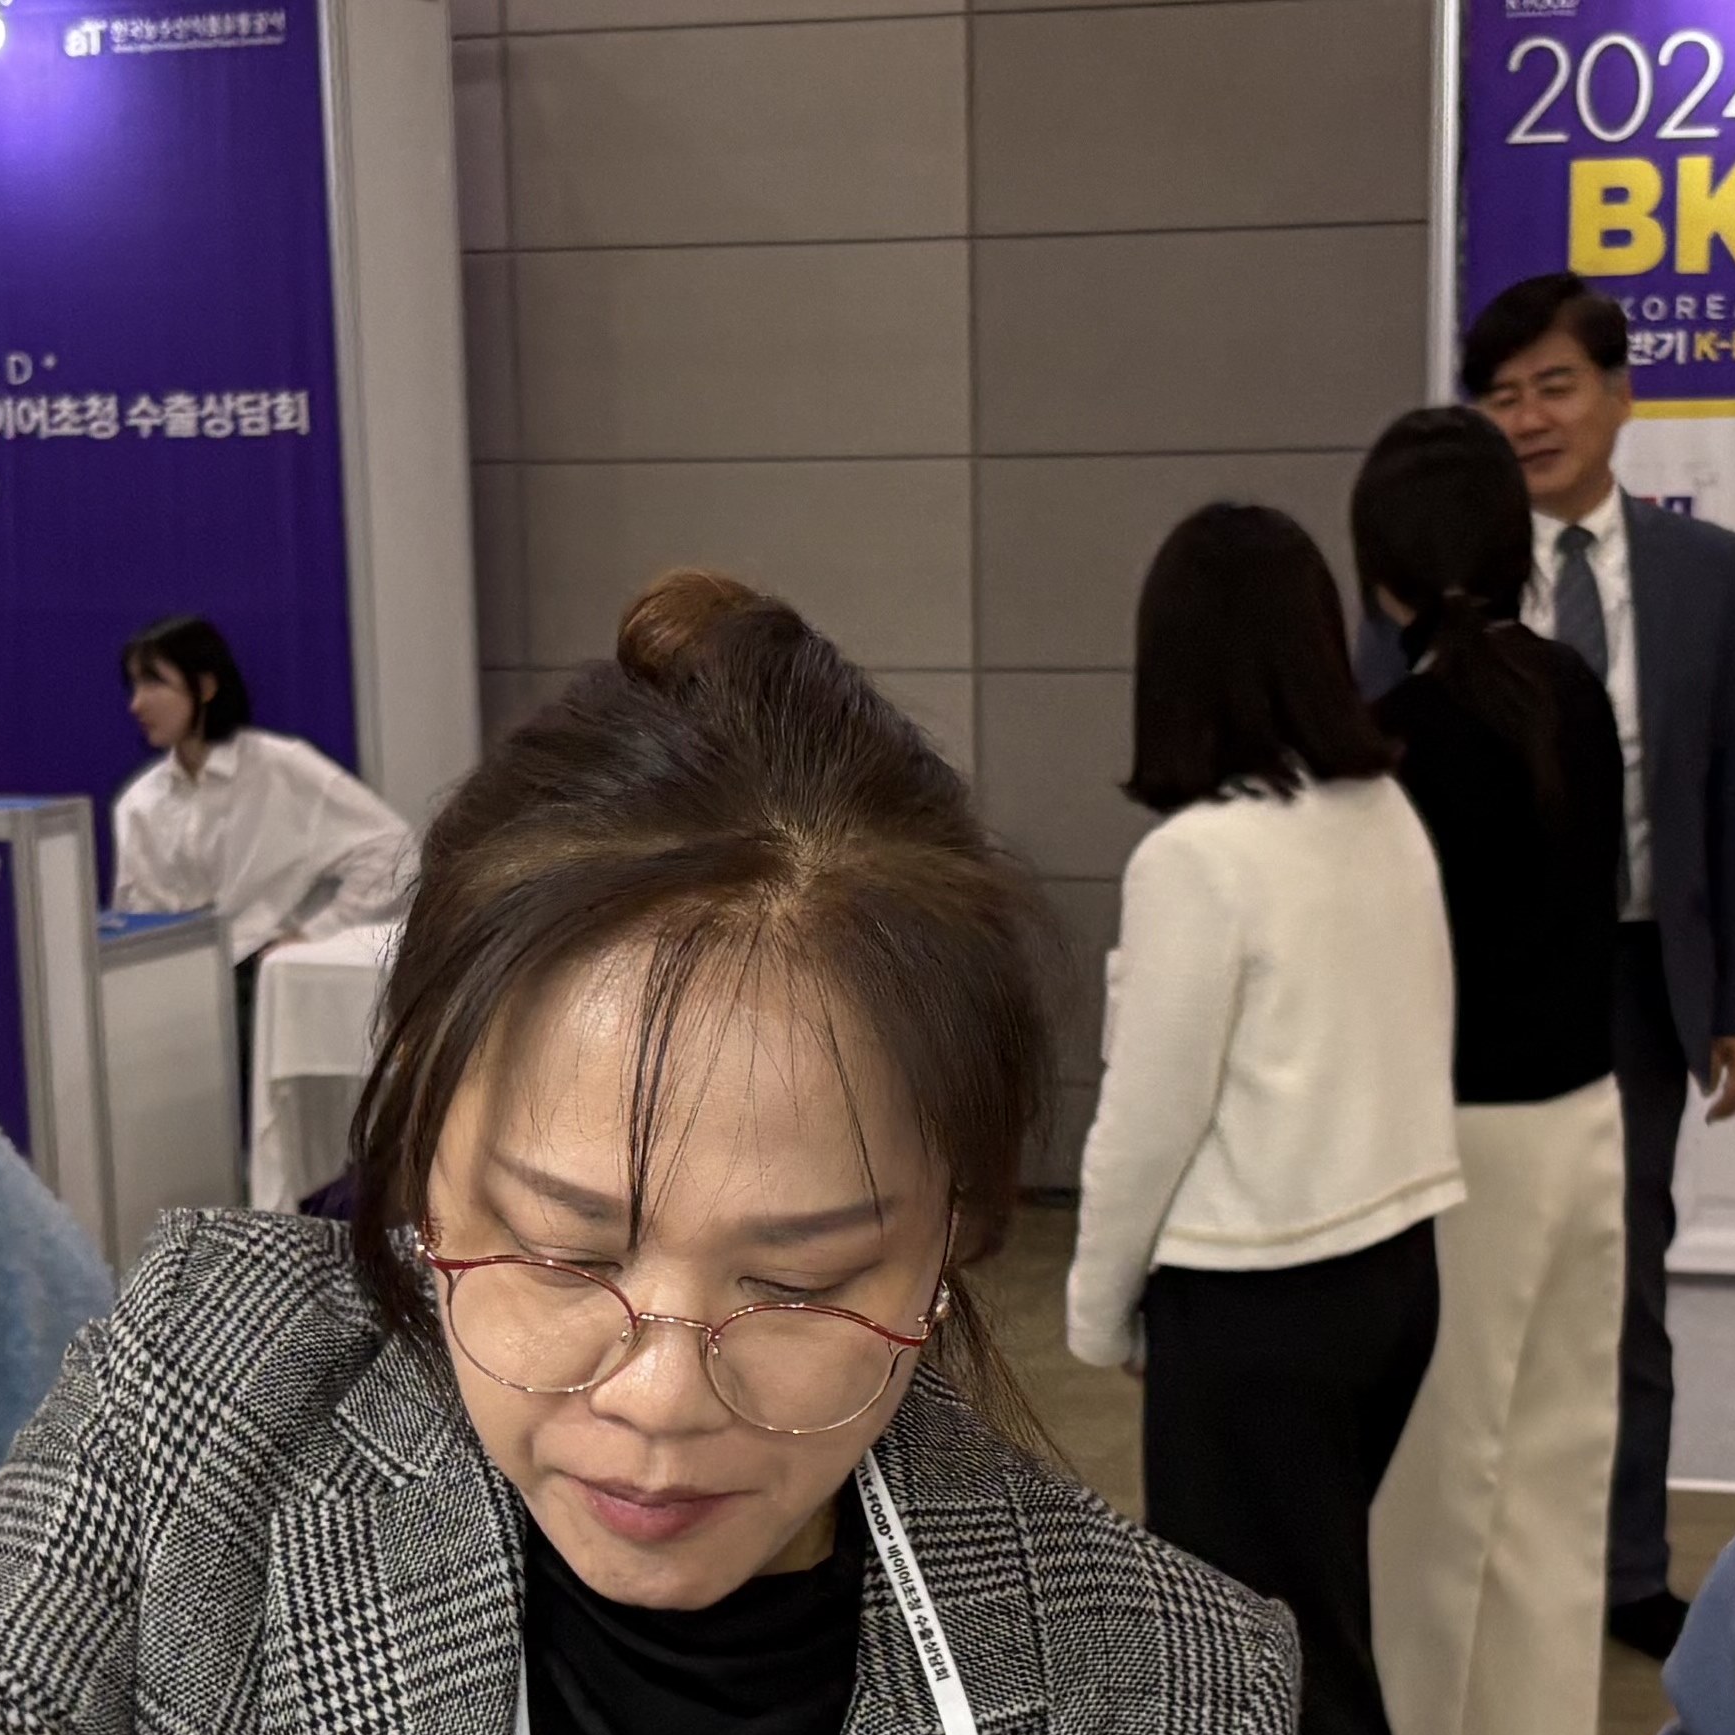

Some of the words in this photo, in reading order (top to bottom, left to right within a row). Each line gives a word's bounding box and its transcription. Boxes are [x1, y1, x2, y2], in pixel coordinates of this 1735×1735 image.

[124, 390, 310, 439] 수출상담회
[886, 1543, 923, 1612] 바이어초청
[913, 1614, 951, 1683] 수출상담회
